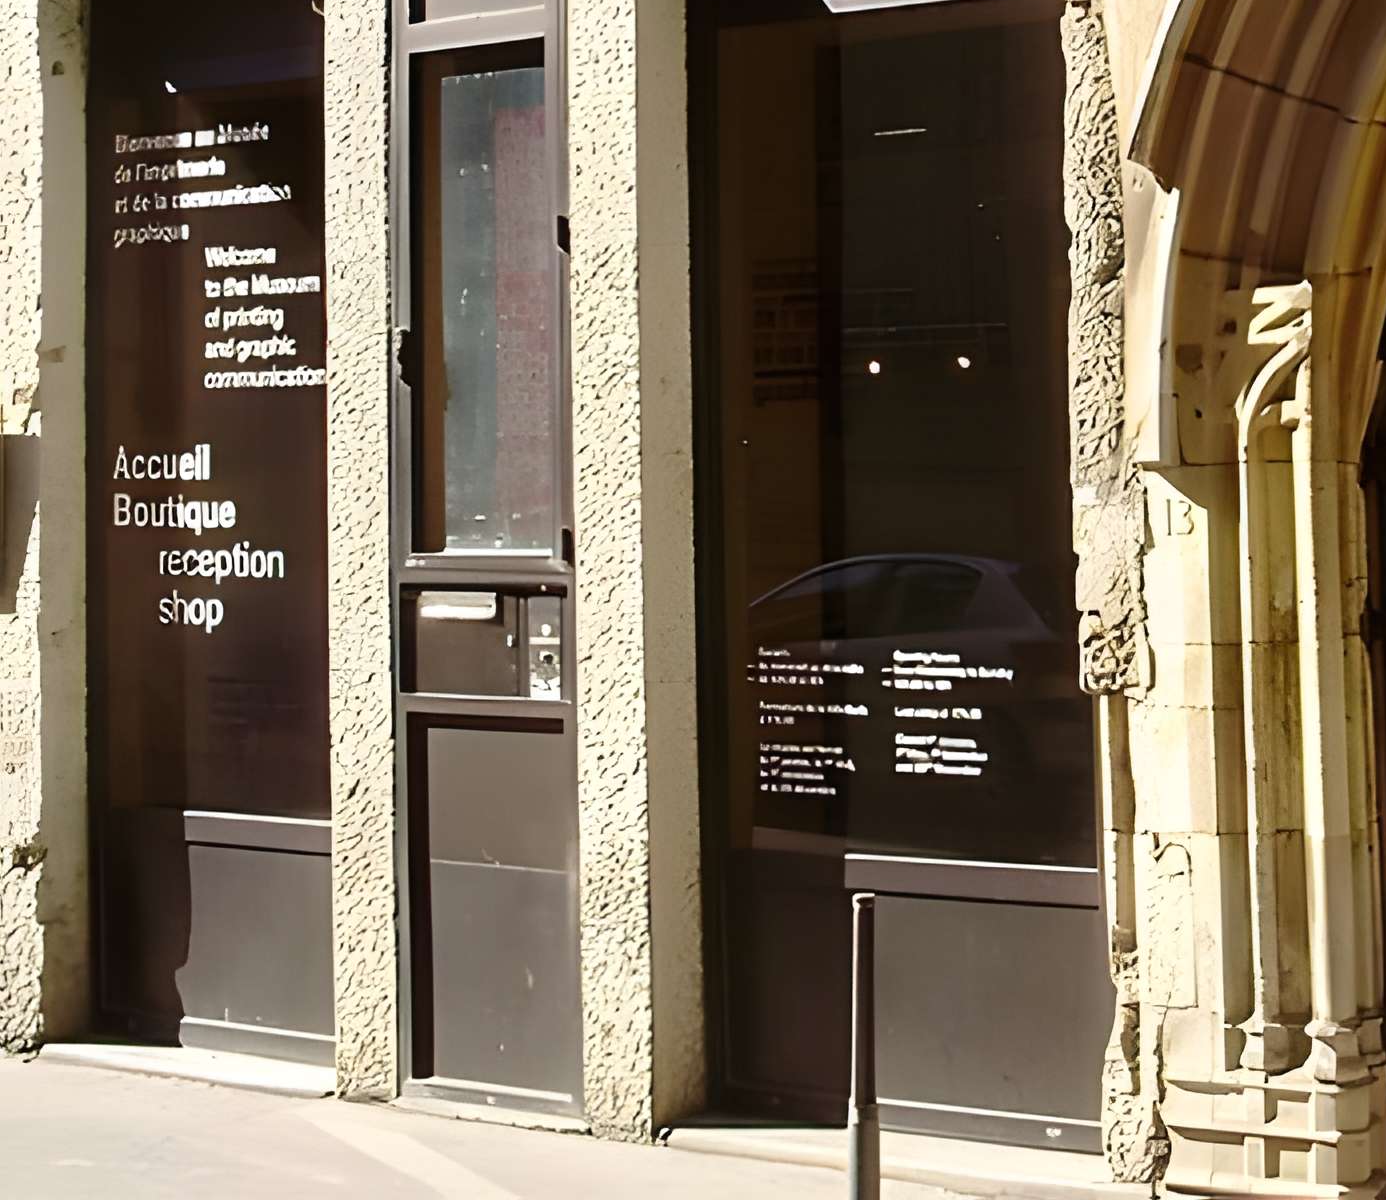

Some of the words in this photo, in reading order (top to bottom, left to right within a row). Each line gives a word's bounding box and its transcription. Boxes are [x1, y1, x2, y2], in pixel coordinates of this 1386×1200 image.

[113, 443, 211, 481] Accueil
[113, 492, 237, 536] Boutique
[1166, 498, 1195, 536] 13
[158, 541, 285, 584] reception
[158, 589, 224, 634] shop
